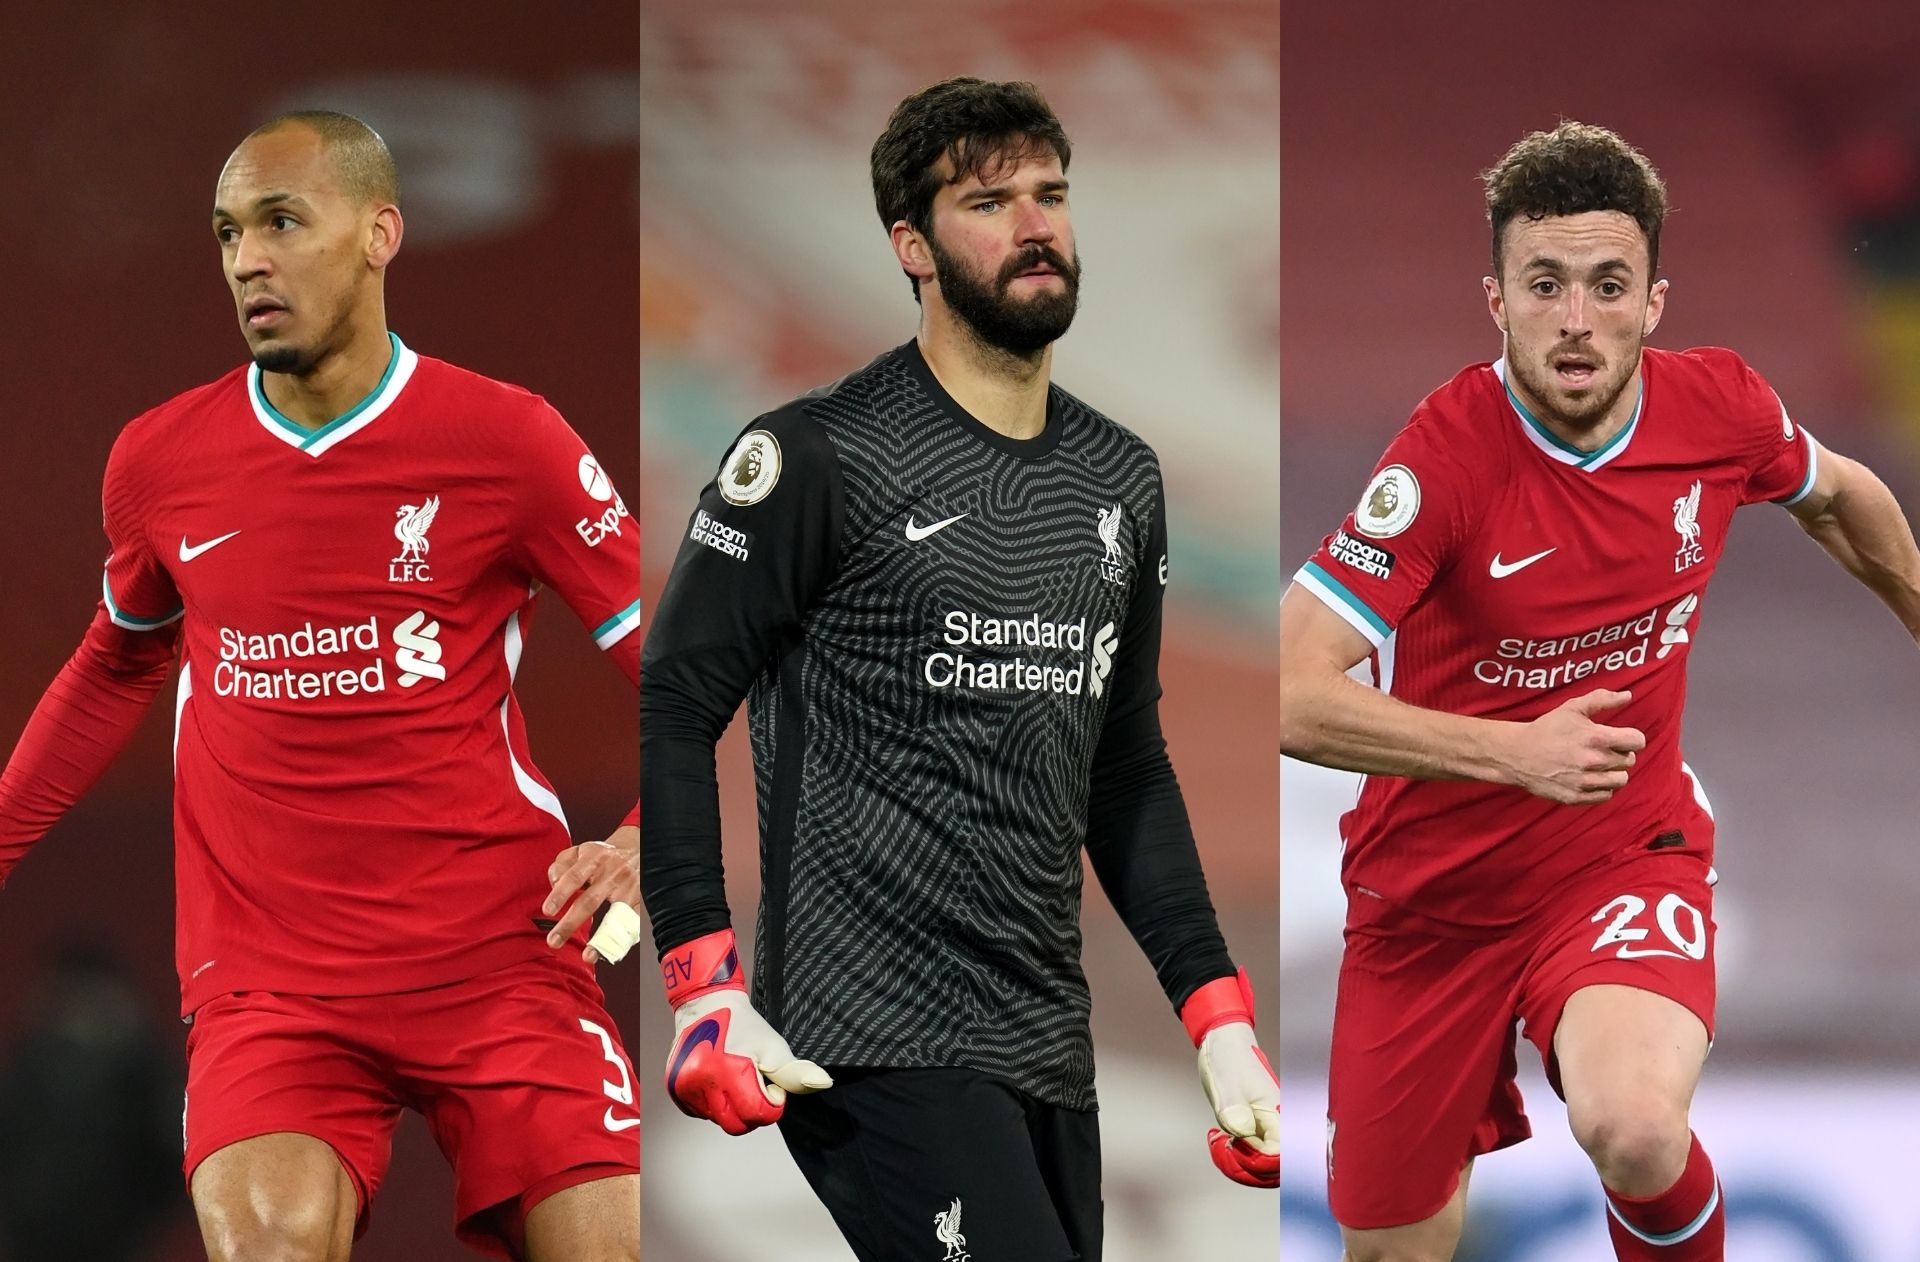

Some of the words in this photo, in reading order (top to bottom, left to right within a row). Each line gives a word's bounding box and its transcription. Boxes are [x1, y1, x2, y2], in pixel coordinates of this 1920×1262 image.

[696, 509, 711, 529] No
[710, 520, 747, 547] room
[703, 532, 749, 562] racism
[1338, 549, 1390, 580] racism
[1345, 539, 1388, 565] room
[219, 615, 380, 661] Standard
[943, 610, 1086, 652] Standard
[1496, 607, 1658, 660] Standard
[213, 658, 386, 700] Chartered
[924, 652, 1086, 696] Chartered
[1473, 637, 1649, 689] Chartered
[1590, 892, 1706, 961] 20
[578, 1018, 634, 1105] 3
